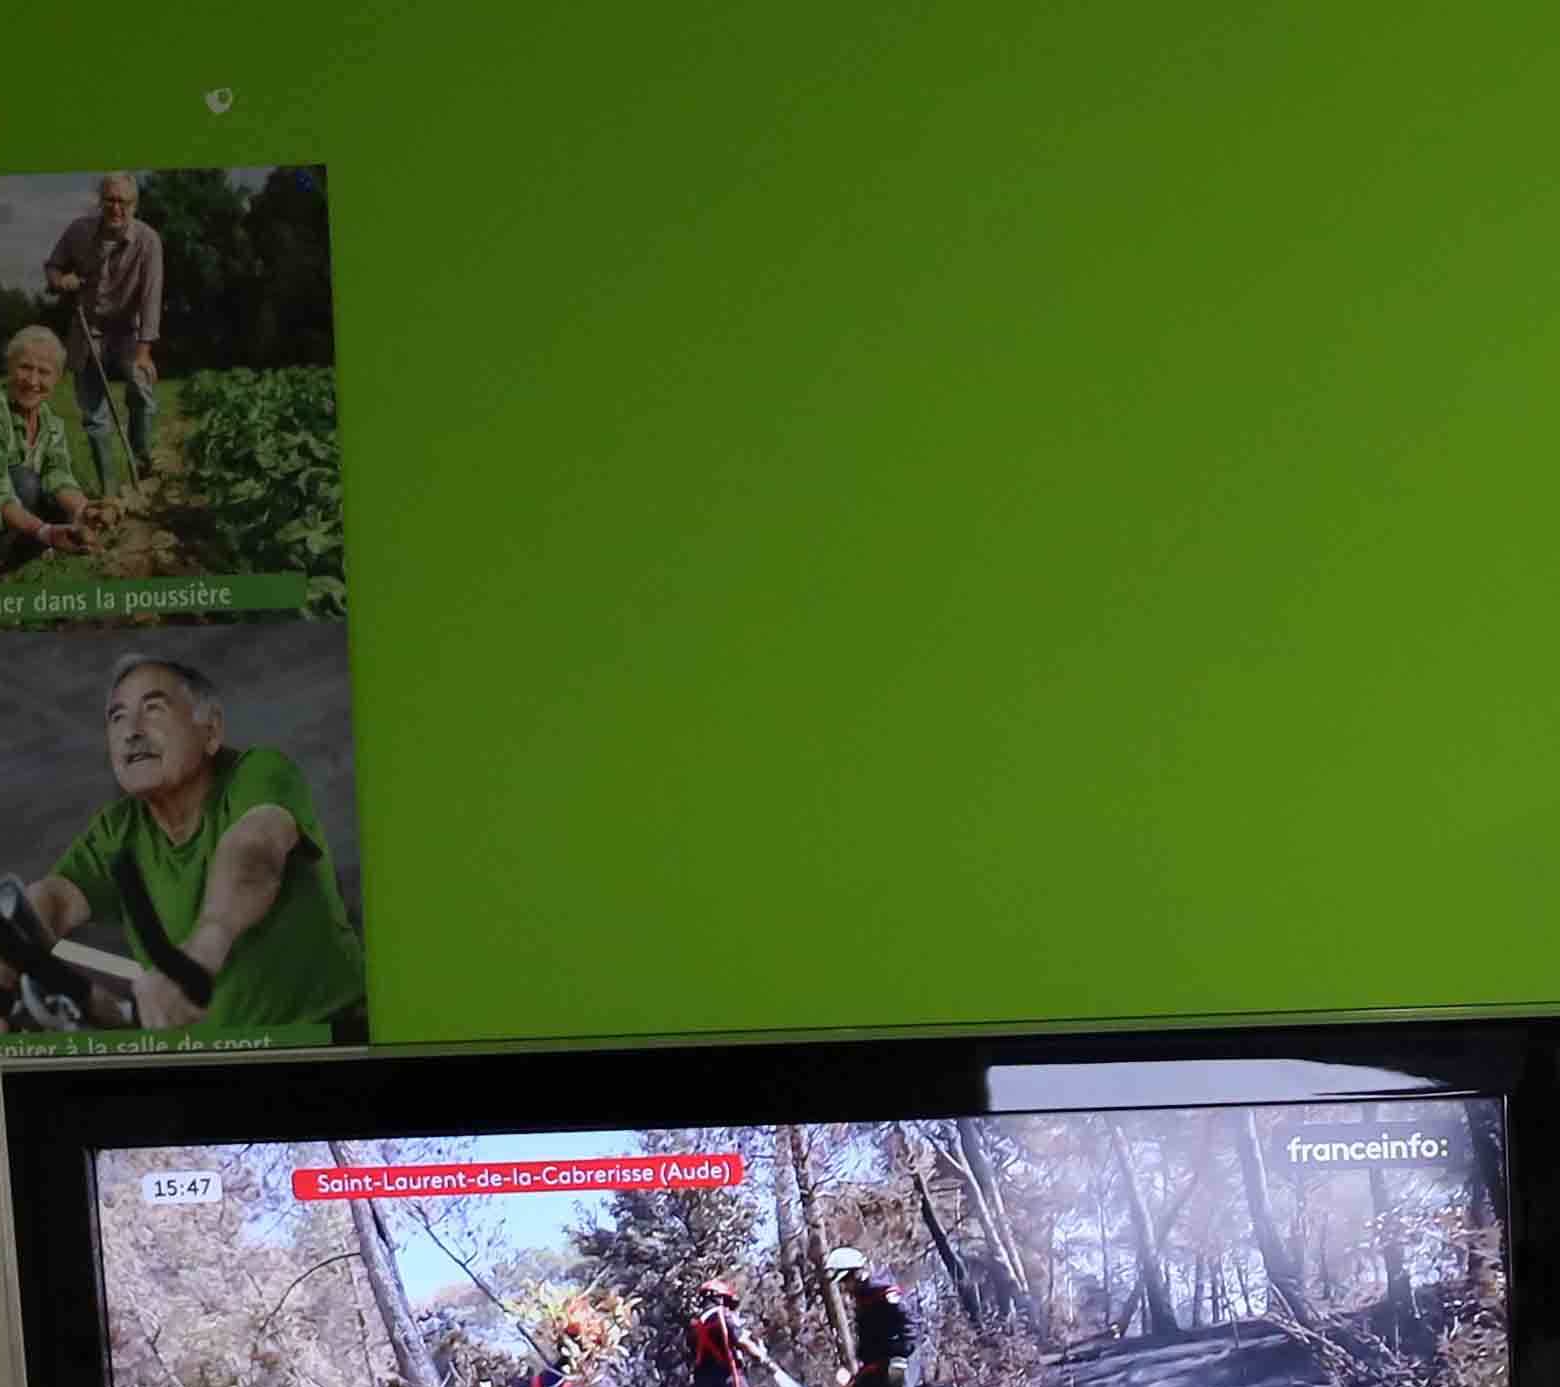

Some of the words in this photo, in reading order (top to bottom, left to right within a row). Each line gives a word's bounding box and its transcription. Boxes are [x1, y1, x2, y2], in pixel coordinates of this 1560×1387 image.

[32, 589, 87, 612] dans
[96, 586, 115, 609] la
[123, 581, 232, 615] poussière
[1287, 1132, 1449, 1162] franceinfo:
[153, 1176, 211, 1198] 15:47
[317, 1163, 654, 1195] Saint-Laurent-de-la-Cabrerisse
[660, 1159, 732, 1184] (Aude)
